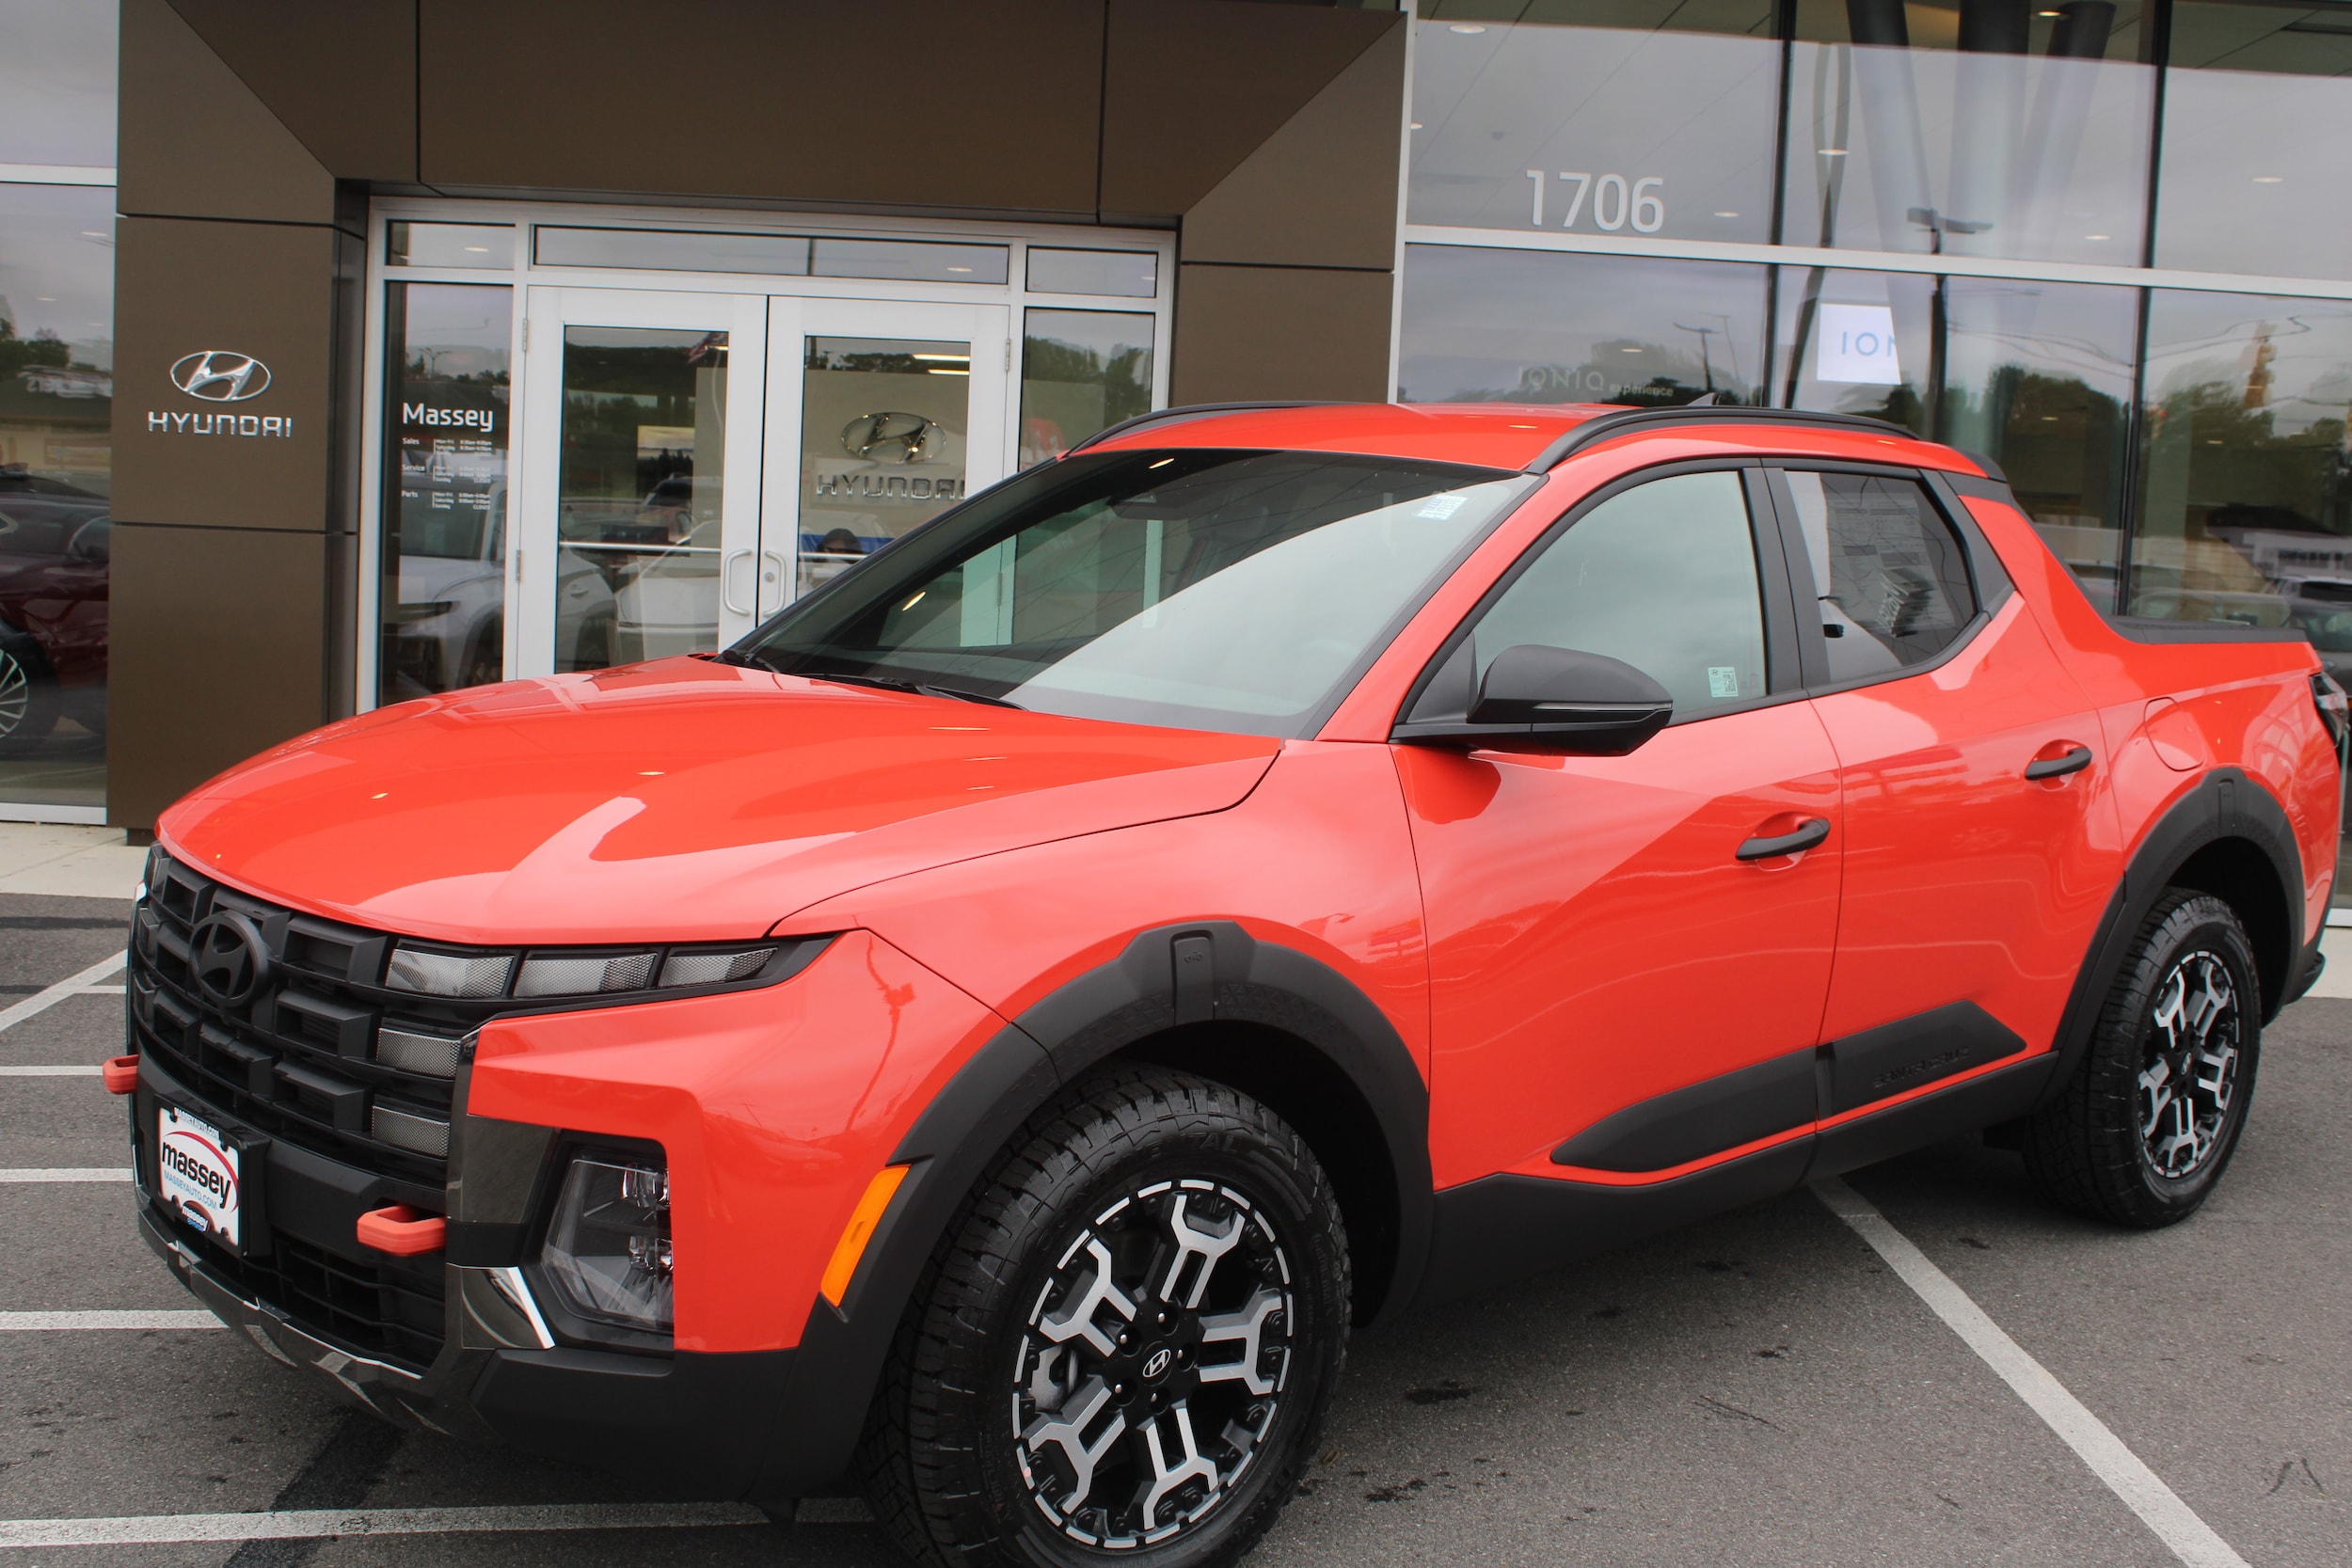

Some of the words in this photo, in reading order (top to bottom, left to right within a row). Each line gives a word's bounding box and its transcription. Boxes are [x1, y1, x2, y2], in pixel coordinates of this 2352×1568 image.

[1526, 169, 1664, 233] 1706
[1518, 365, 1604, 391] IONIQ
[1609, 383, 1674, 397] experience
[148, 411, 293, 437] HYUNDAI
[403, 402, 494, 433] Massey
[402, 436, 420, 445] Sales
[402, 464, 426, 472] Service
[817, 474, 965, 499] HYUNDAI
[162, 1141, 231, 1210] massey
